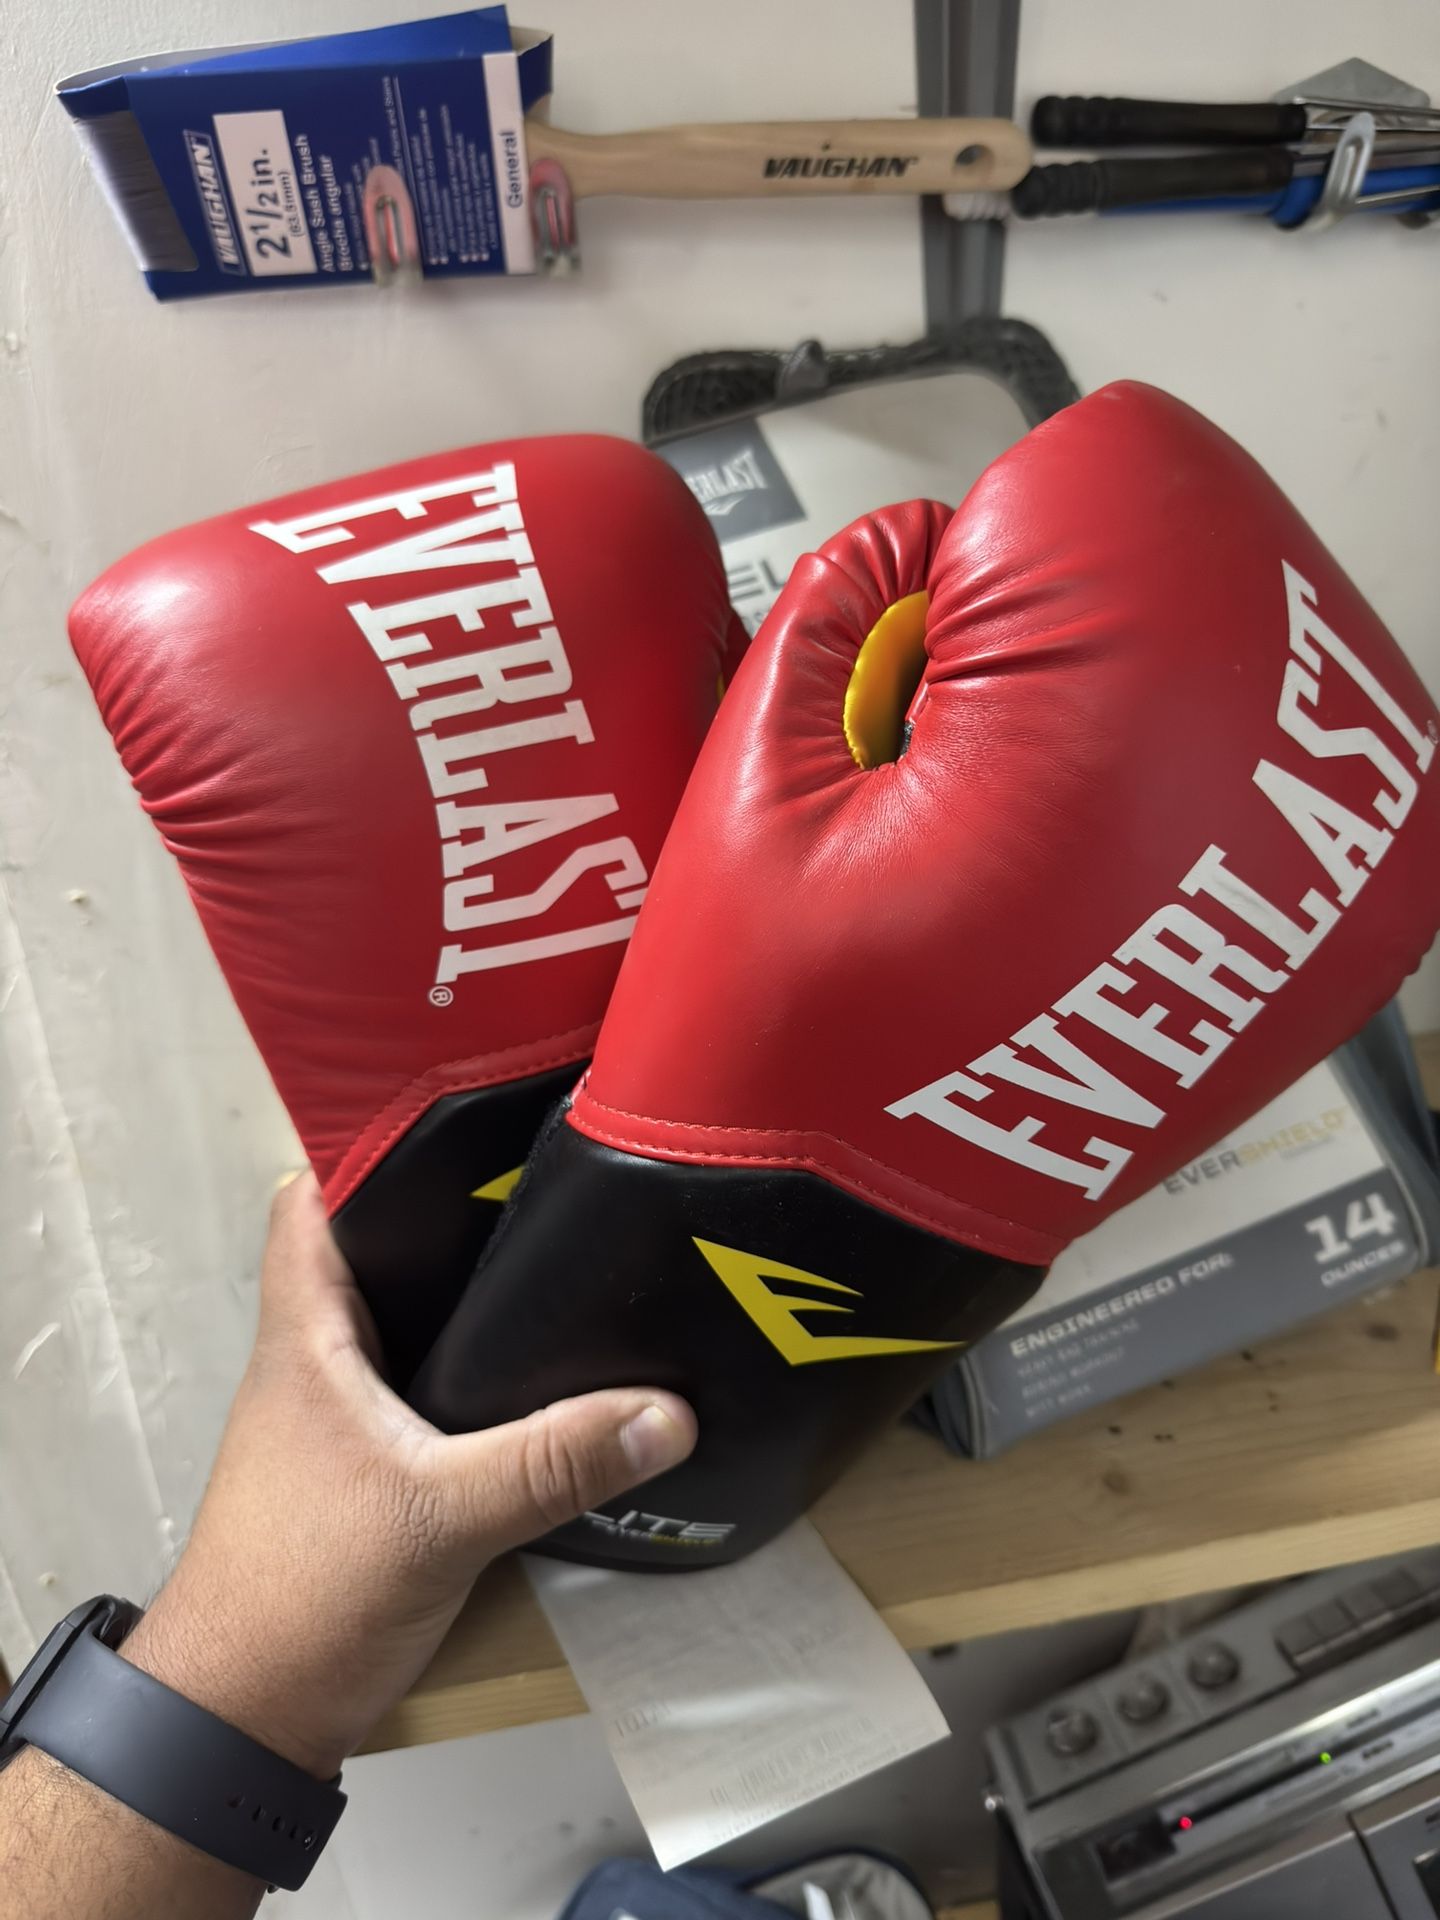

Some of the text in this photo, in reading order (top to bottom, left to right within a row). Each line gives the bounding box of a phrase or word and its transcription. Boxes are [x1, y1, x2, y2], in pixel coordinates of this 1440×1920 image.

[191, 142, 240, 264] VAUGHAN
[251, 149, 275, 187] in.
[295, 133, 335, 272] Angle Sash Brush
[499, 130, 522, 208] General
[763, 155, 913, 179] VAUGHAN
[319, 154, 352, 272] Brocha angular
[685, 449, 767, 499] ERLAST
[1163, 1107, 1345, 1194] EVERSHIELD
[1305, 1193, 1396, 1264] 14
[1320, 1240, 1406, 1287] OUNCES
[1010, 1276, 1176, 1358] ENGINEERED
